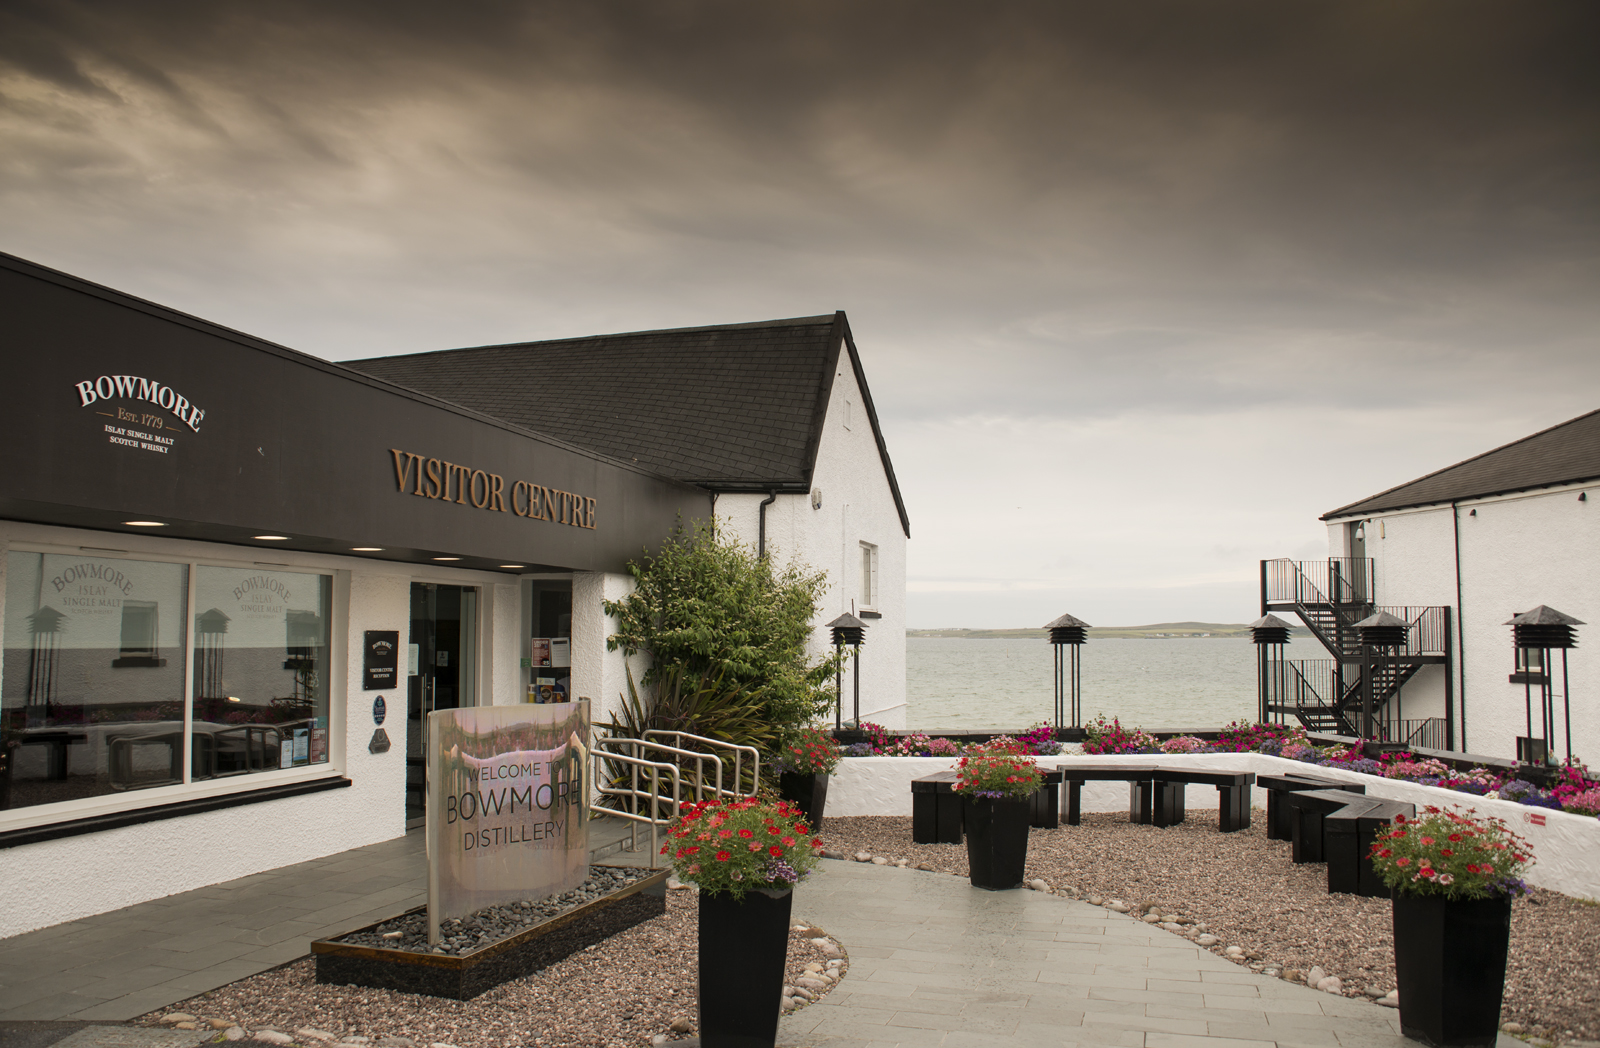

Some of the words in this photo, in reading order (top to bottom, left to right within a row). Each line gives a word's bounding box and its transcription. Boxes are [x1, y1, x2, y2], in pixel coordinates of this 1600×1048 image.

[75, 375, 204, 433] BOWMORE
[141, 413, 163, 429] 1779
[104, 424, 126, 436] ISLAY
[127, 429, 153, 441] SINGLE
[155, 435, 174, 446] MALT
[110, 436, 138, 448] SCOTCH
[140, 442, 168, 454] WHISKY
[391, 448, 508, 512] VISITOR
[511, 480, 597, 530] CENTRE
[51, 563, 133, 596] BOWMORE
[79, 585, 108, 596] ISLAY
[232, 575, 291, 604] BOWMORE
[63, 597, 96, 607] SINGLE
[98, 599, 121, 608] MALT
[241, 604, 265, 613] SINGLE
[266, 605, 282, 613] MALT
[252, 594, 273, 604] ISLAY
[468, 762, 541, 782] WELCOME
[546, 760, 562, 775] TO
[447, 778, 580, 825] BOWMORE
[464, 819, 565, 851] DISTILLERY
